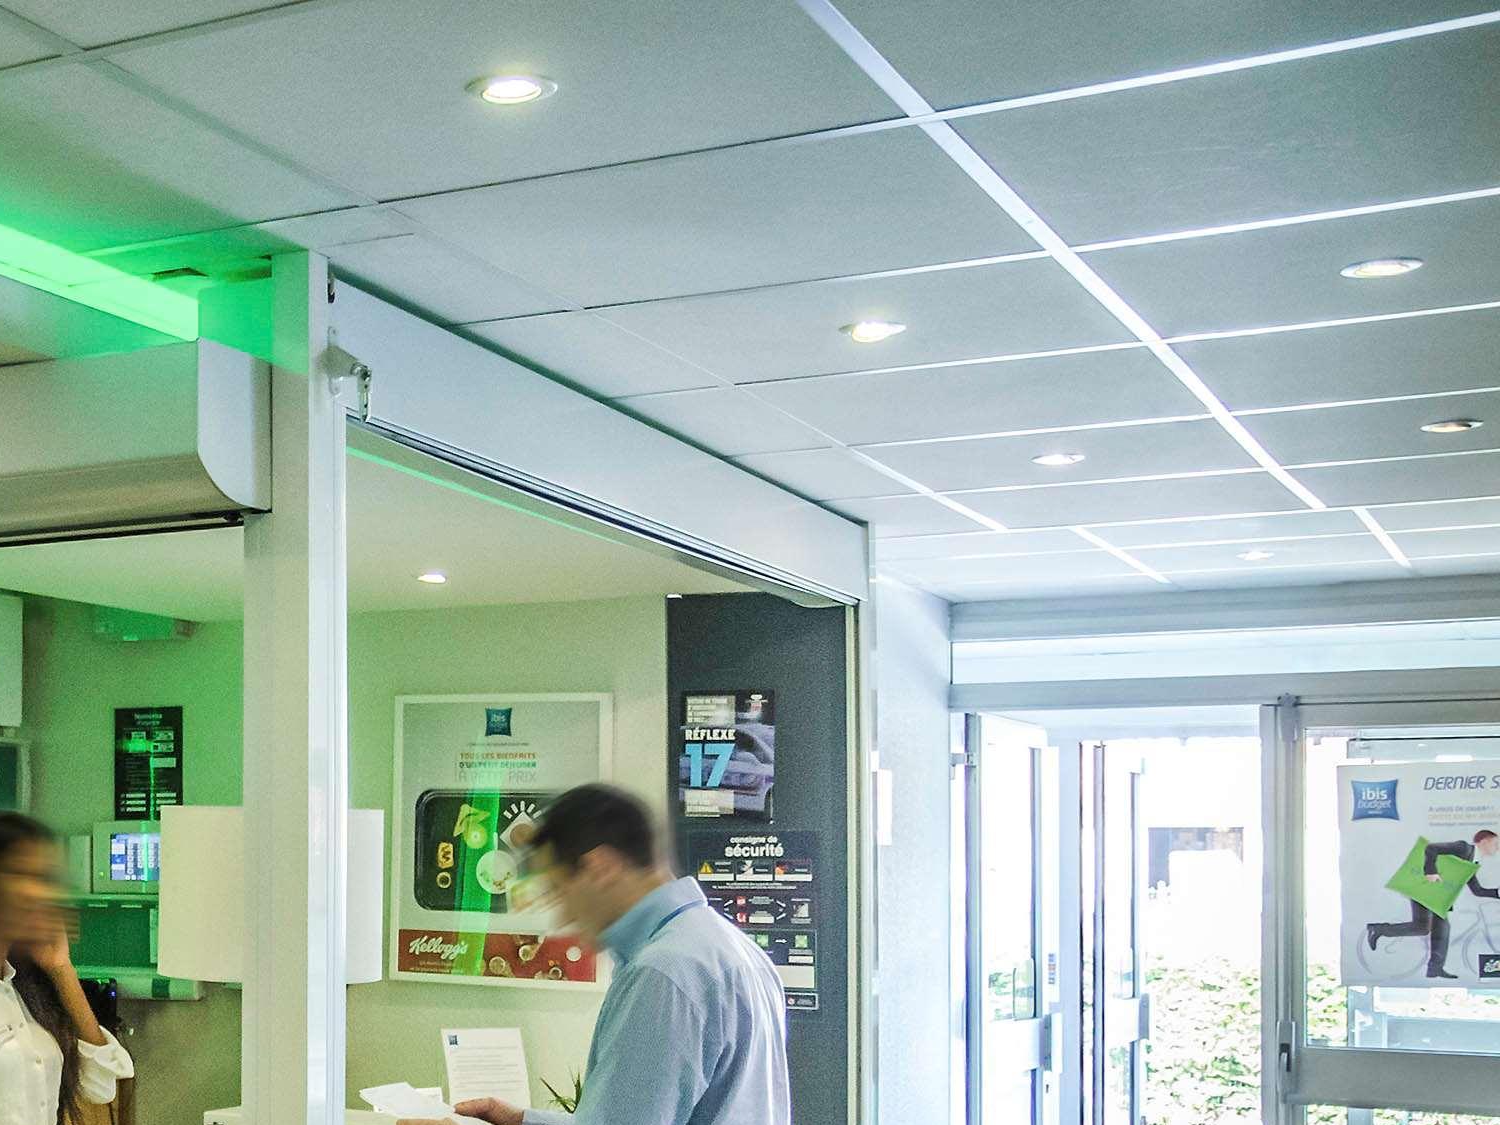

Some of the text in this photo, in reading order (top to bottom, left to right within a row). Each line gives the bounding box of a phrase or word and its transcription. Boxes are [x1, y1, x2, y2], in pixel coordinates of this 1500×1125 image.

[684, 726, 736, 741] RÉFLEXE
[684, 743, 736, 787] 17
[1424, 776, 1486, 790] DERNIER
[1362, 787, 1389, 800] ibis
[724, 843, 785, 857] sécurité
[408, 935, 469, 960] Kellogg's
